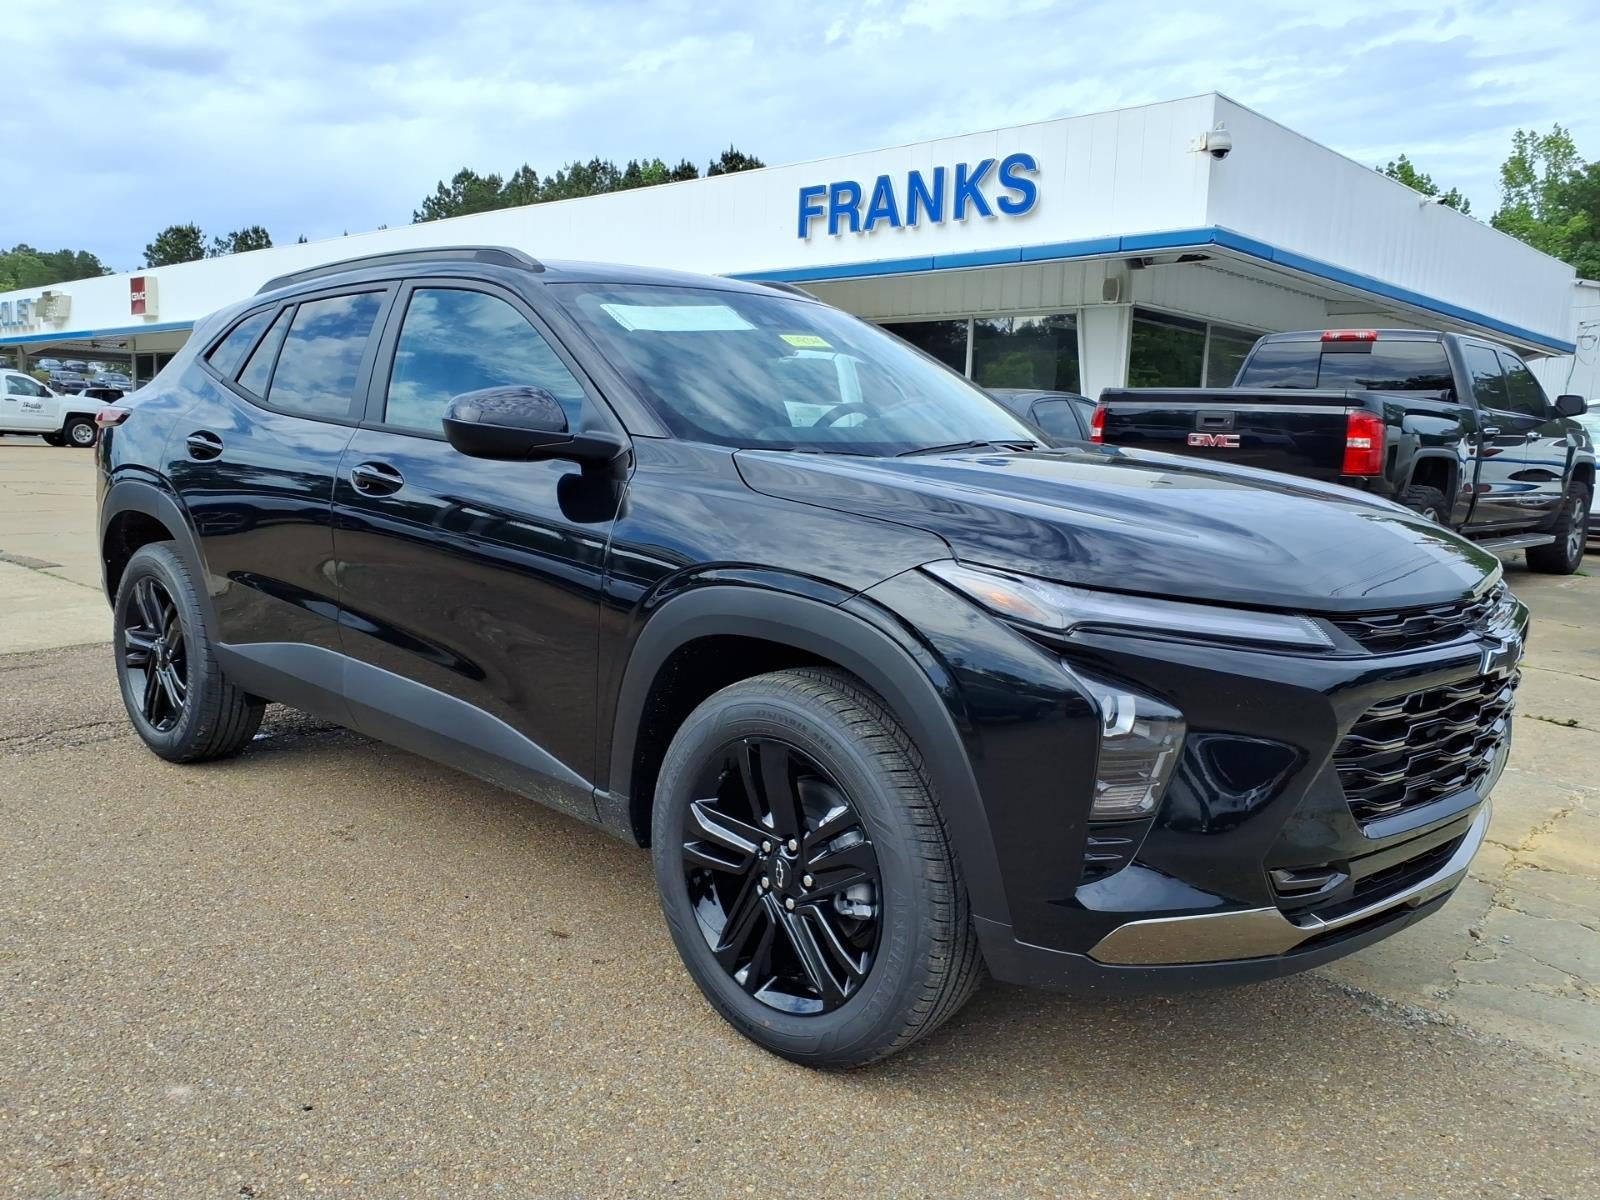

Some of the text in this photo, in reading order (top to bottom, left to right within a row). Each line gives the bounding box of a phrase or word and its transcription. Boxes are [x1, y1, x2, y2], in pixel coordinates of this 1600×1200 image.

[798, 153, 1039, 239] FRANKS
[131, 291, 146, 301] GMC
[1188, 433, 1240, 447] GMC
